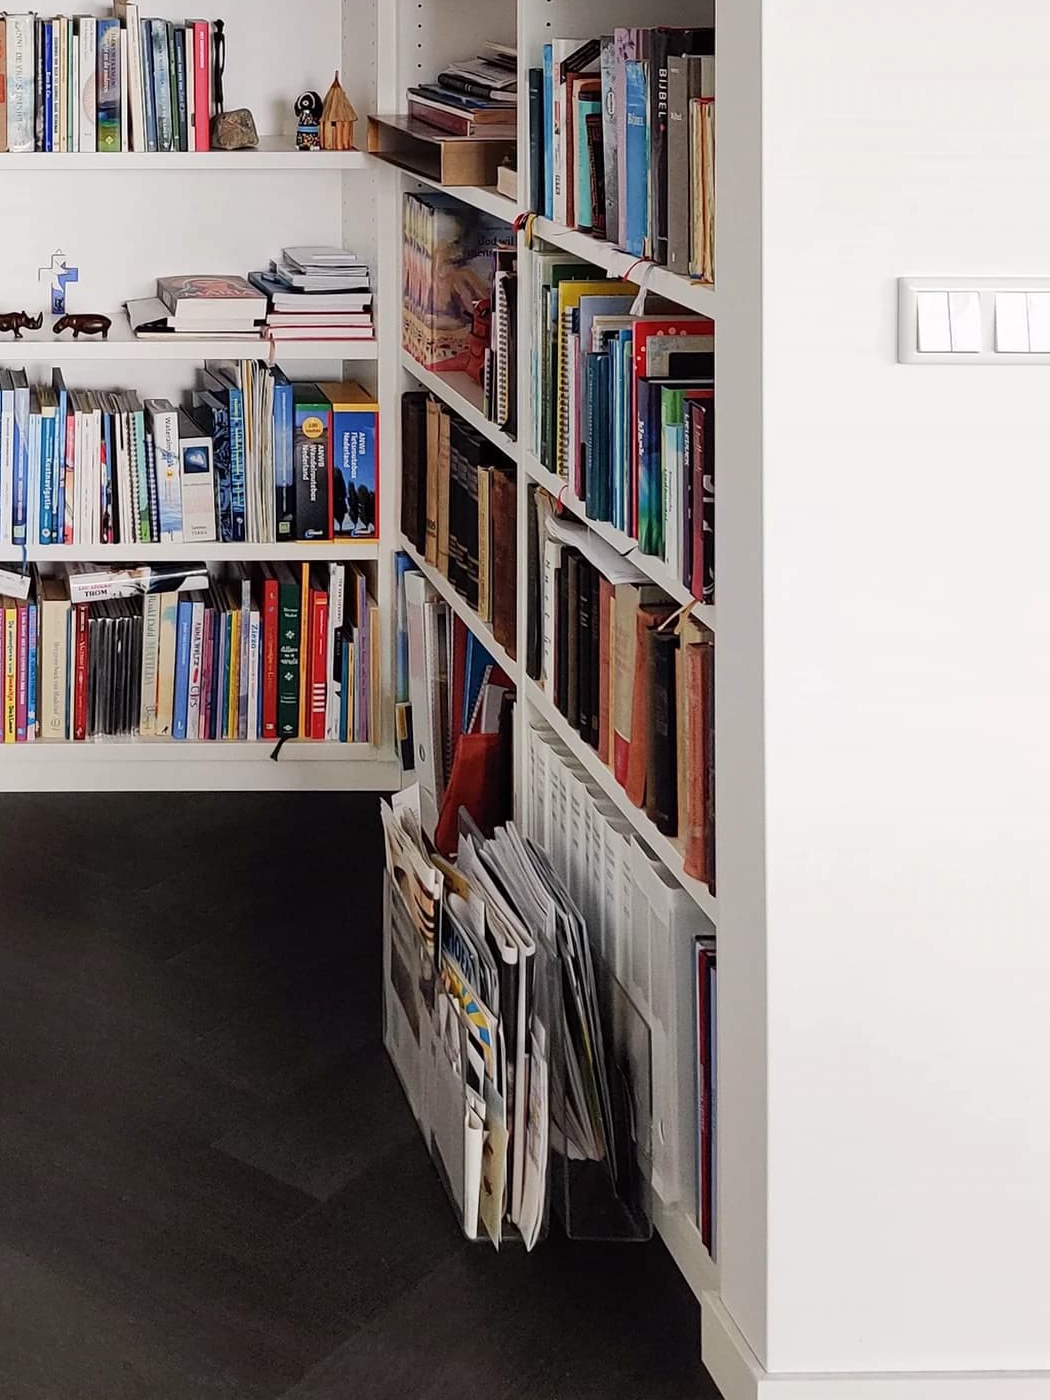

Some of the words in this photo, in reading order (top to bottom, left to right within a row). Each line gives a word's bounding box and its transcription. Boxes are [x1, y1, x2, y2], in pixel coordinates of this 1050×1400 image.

[658, 68, 668, 118] BIJBEL
[350, 432, 358, 478] Fietsroutebox
[250, 624, 258, 649] Ziezo
